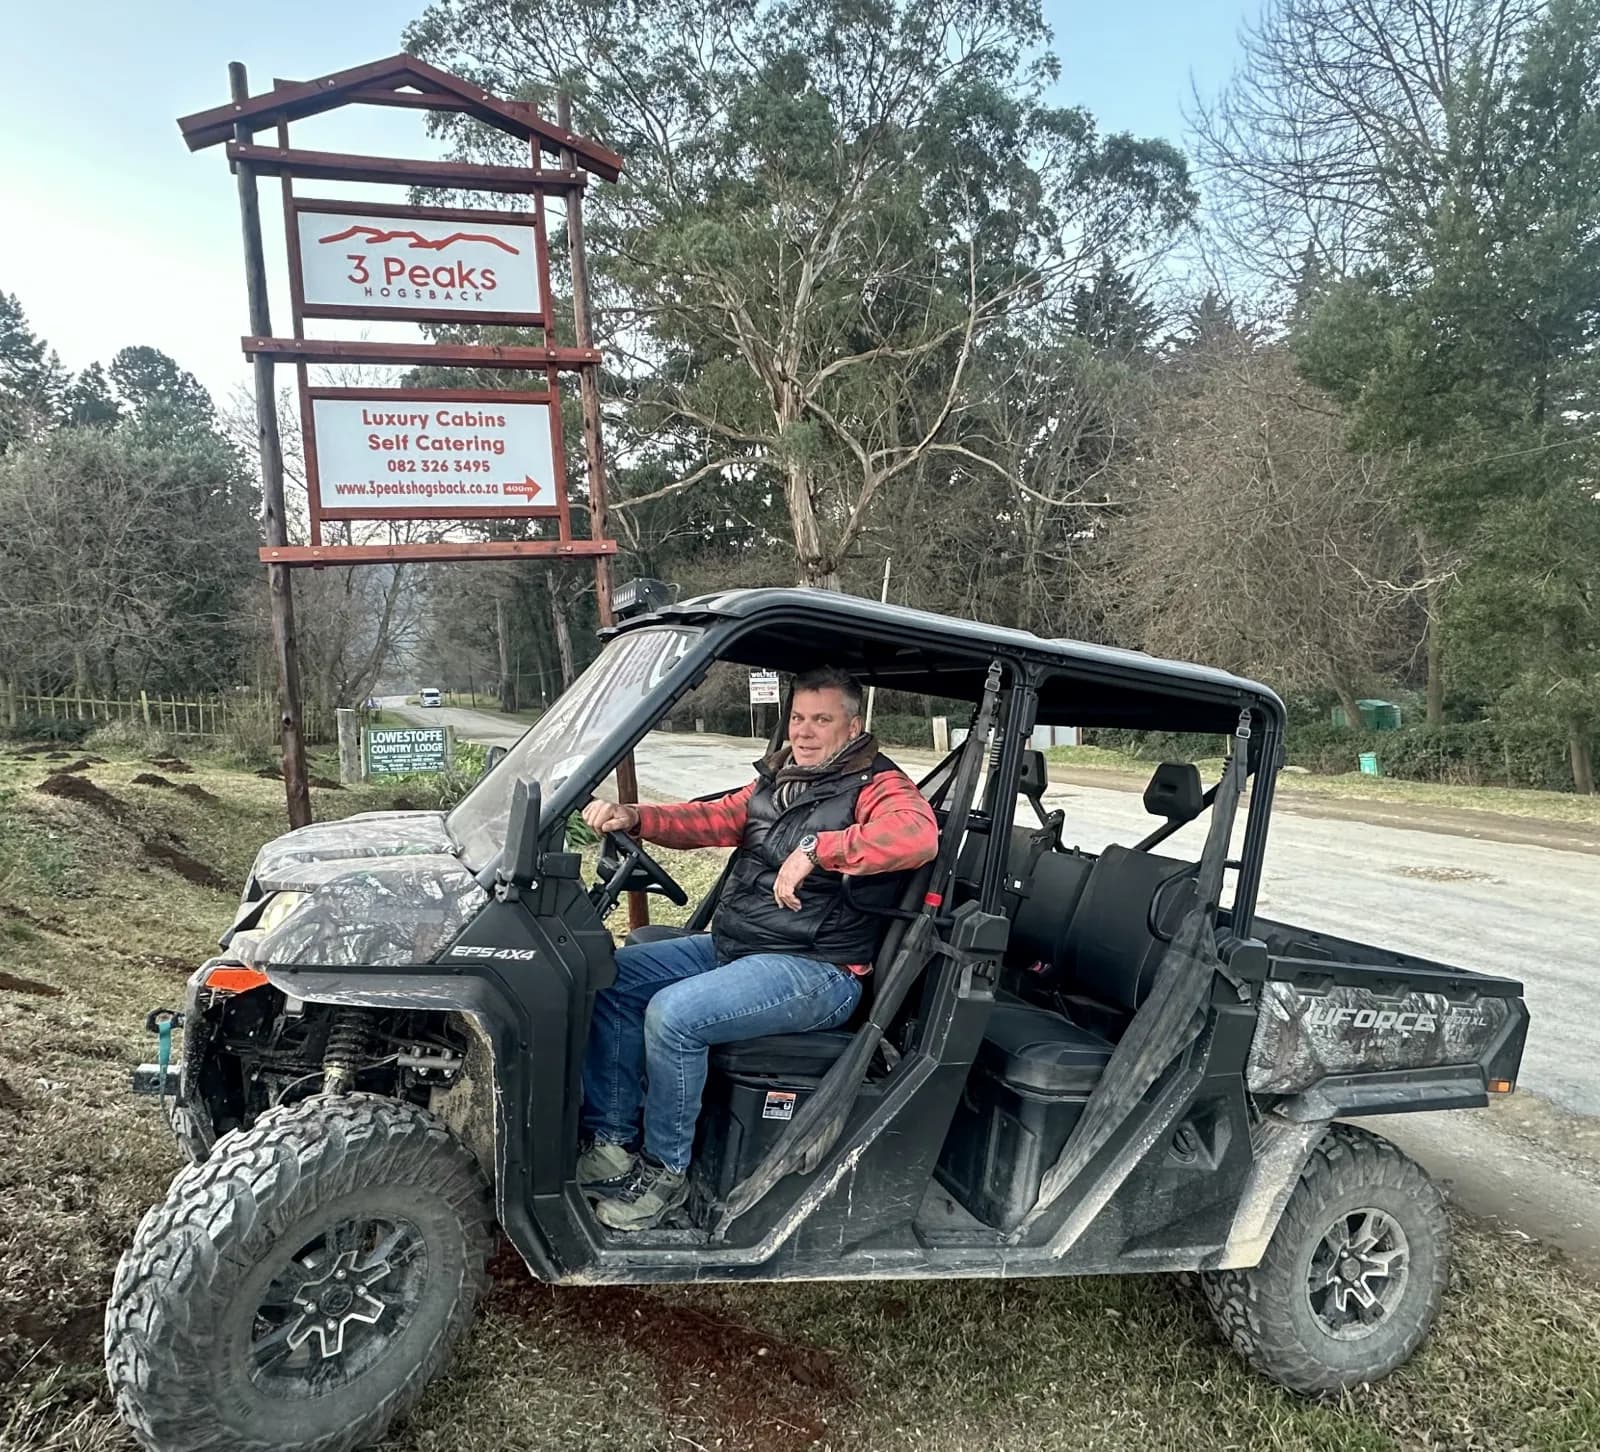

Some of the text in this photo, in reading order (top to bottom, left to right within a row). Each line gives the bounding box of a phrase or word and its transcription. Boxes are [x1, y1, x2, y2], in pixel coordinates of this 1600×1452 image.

[347, 254, 497, 291] 3 Peaks
[364, 286, 483, 302] HOGSBACK
[362, 409, 506, 429] Luxury Cabins
[368, 434, 505, 455] Self Catering
[387, 459, 490, 472] 082 326 3495
[335, 479, 498, 498] www.3peakshogsback.co.za
[370, 730, 443, 743] LOWESTOFFE
[371, 743, 443, 754] COUNTRY LODGE
[450, 946, 496, 957] EPS
[1311, 1007, 1437, 1032] UFORCE
